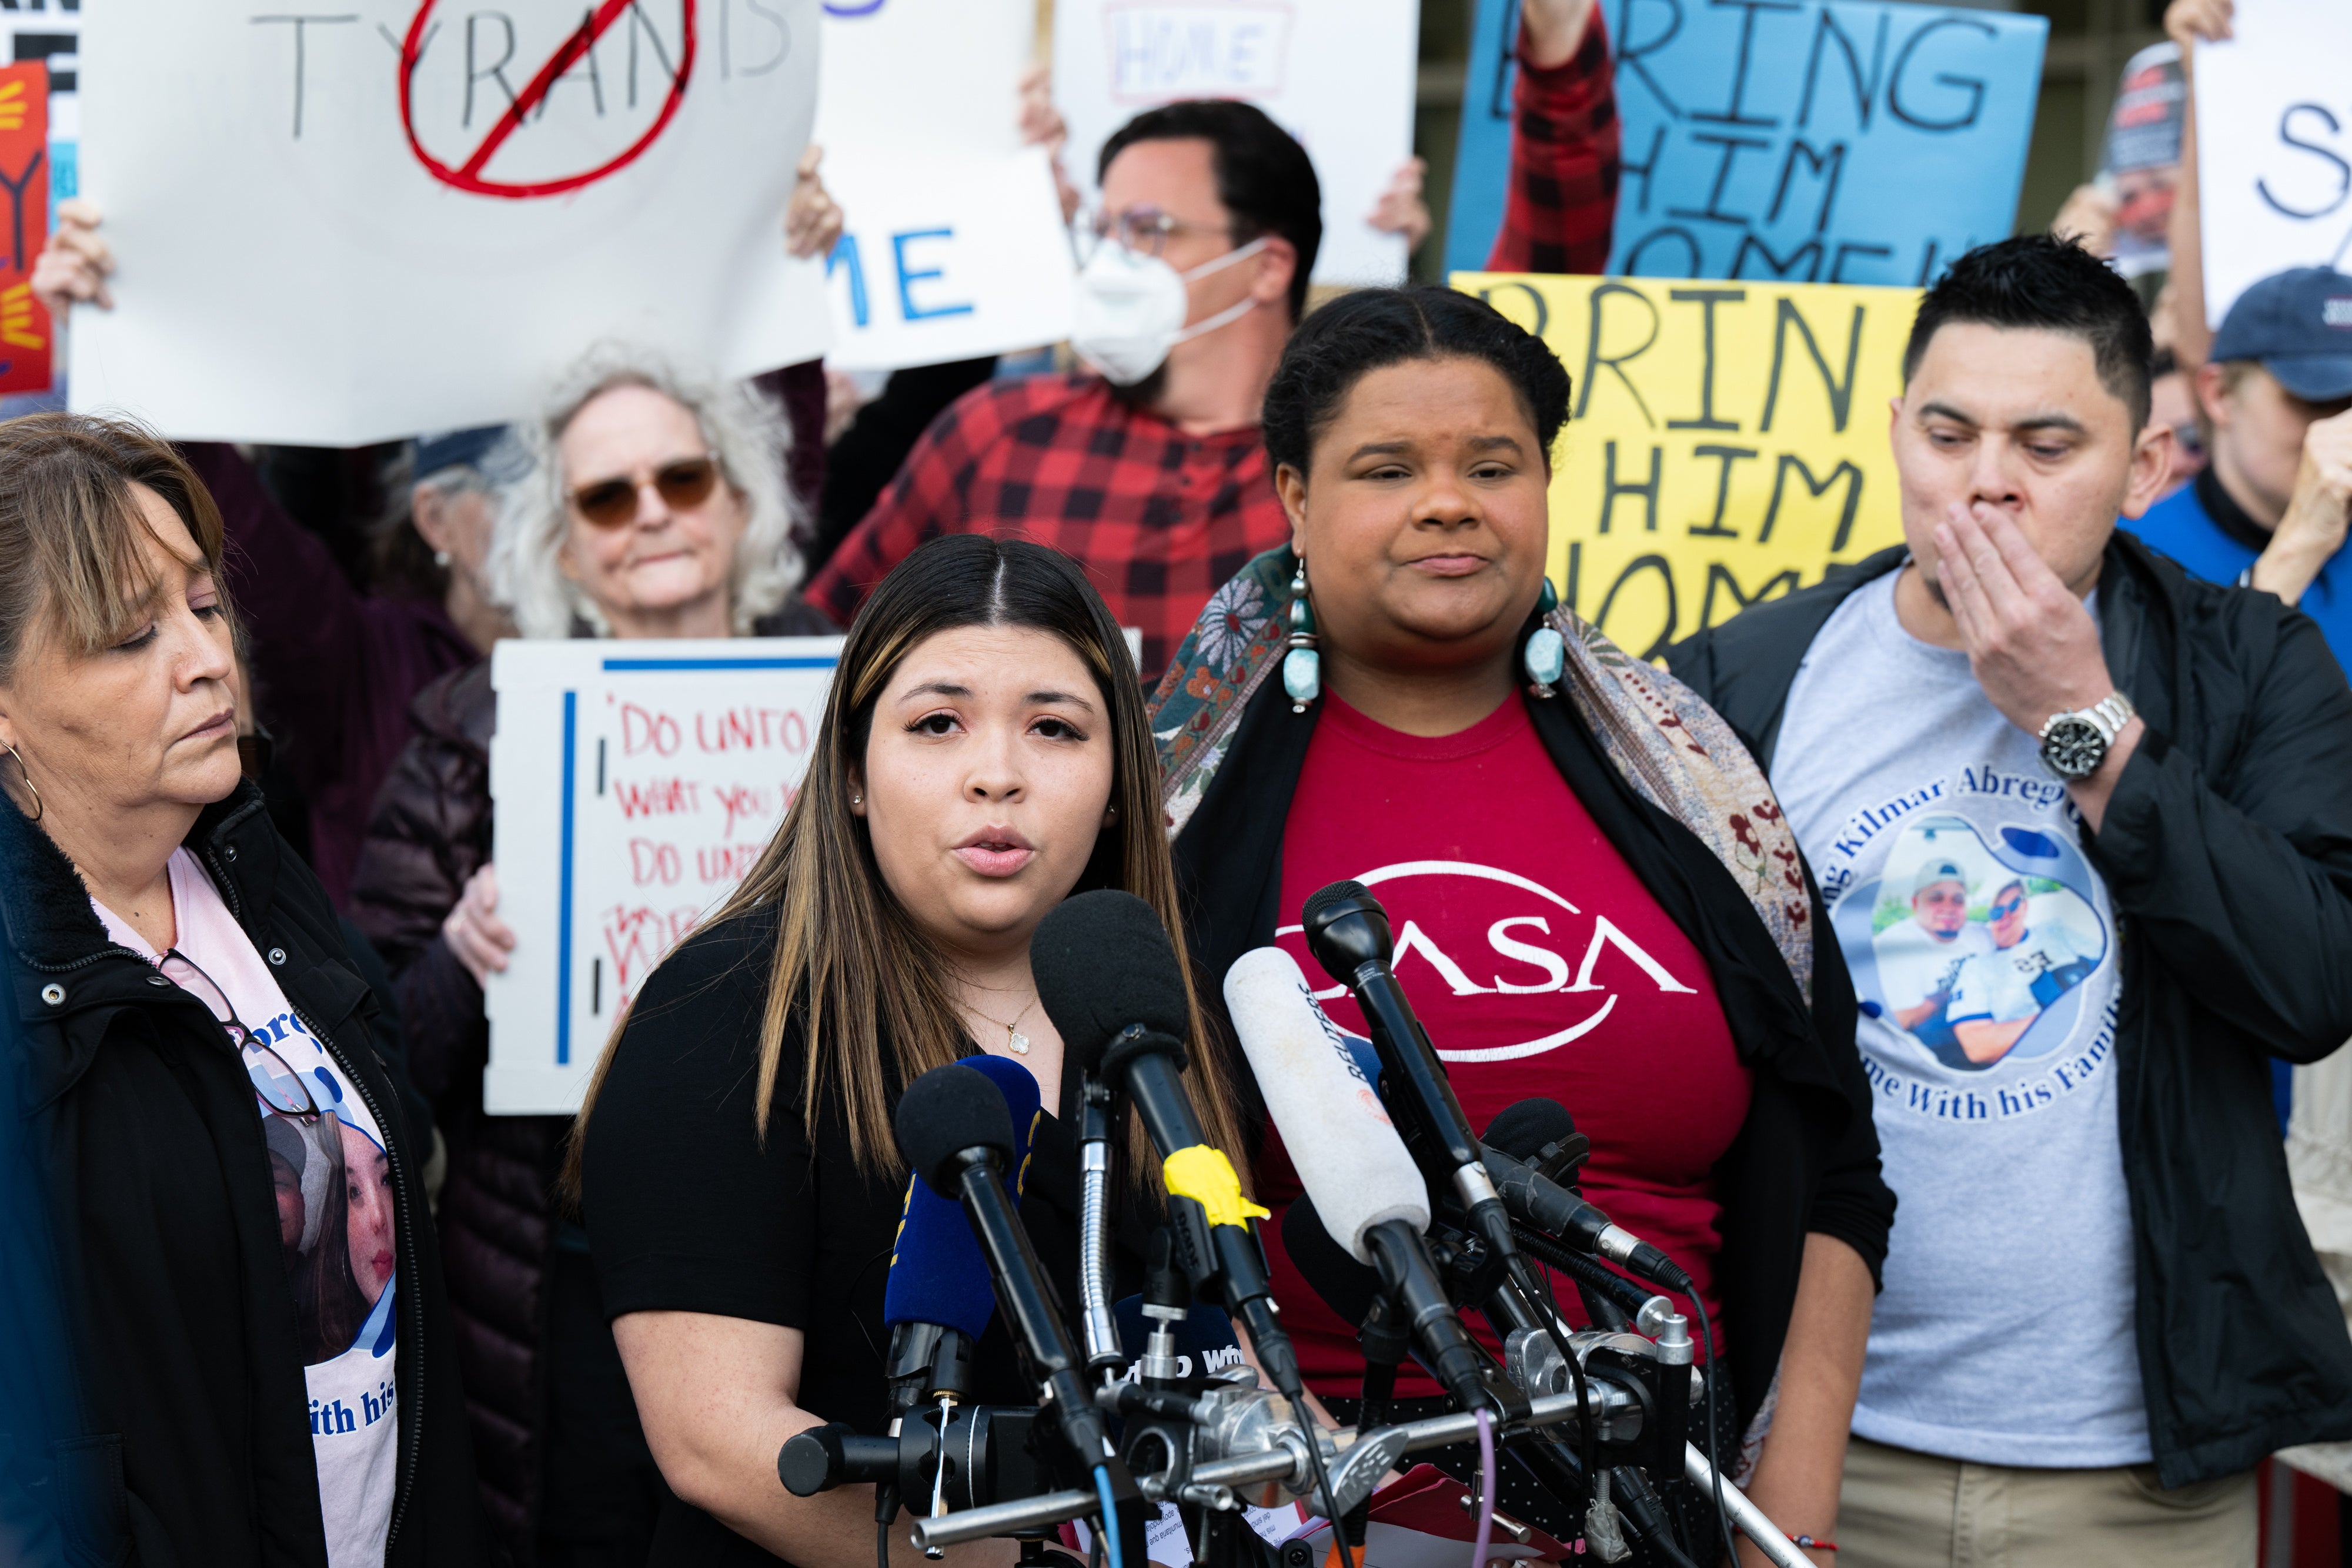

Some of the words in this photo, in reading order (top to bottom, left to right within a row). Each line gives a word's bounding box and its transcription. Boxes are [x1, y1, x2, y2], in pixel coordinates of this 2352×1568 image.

[1599, 440, 1863, 553] HIM
[696, 706, 808, 755] UNTO
[1835, 779, 1945, 858] Kilmar
[629, 837, 682, 886] DO
[1910, 1082, 1987, 1119] With
[1999, 1082, 2052, 1116] his
[309, 1399, 357, 1436] ith
[360, 1380, 395, 1427] his
[1149, 1534, 1159, 1545] que
[1266, 1524, 1276, 1534] mis
